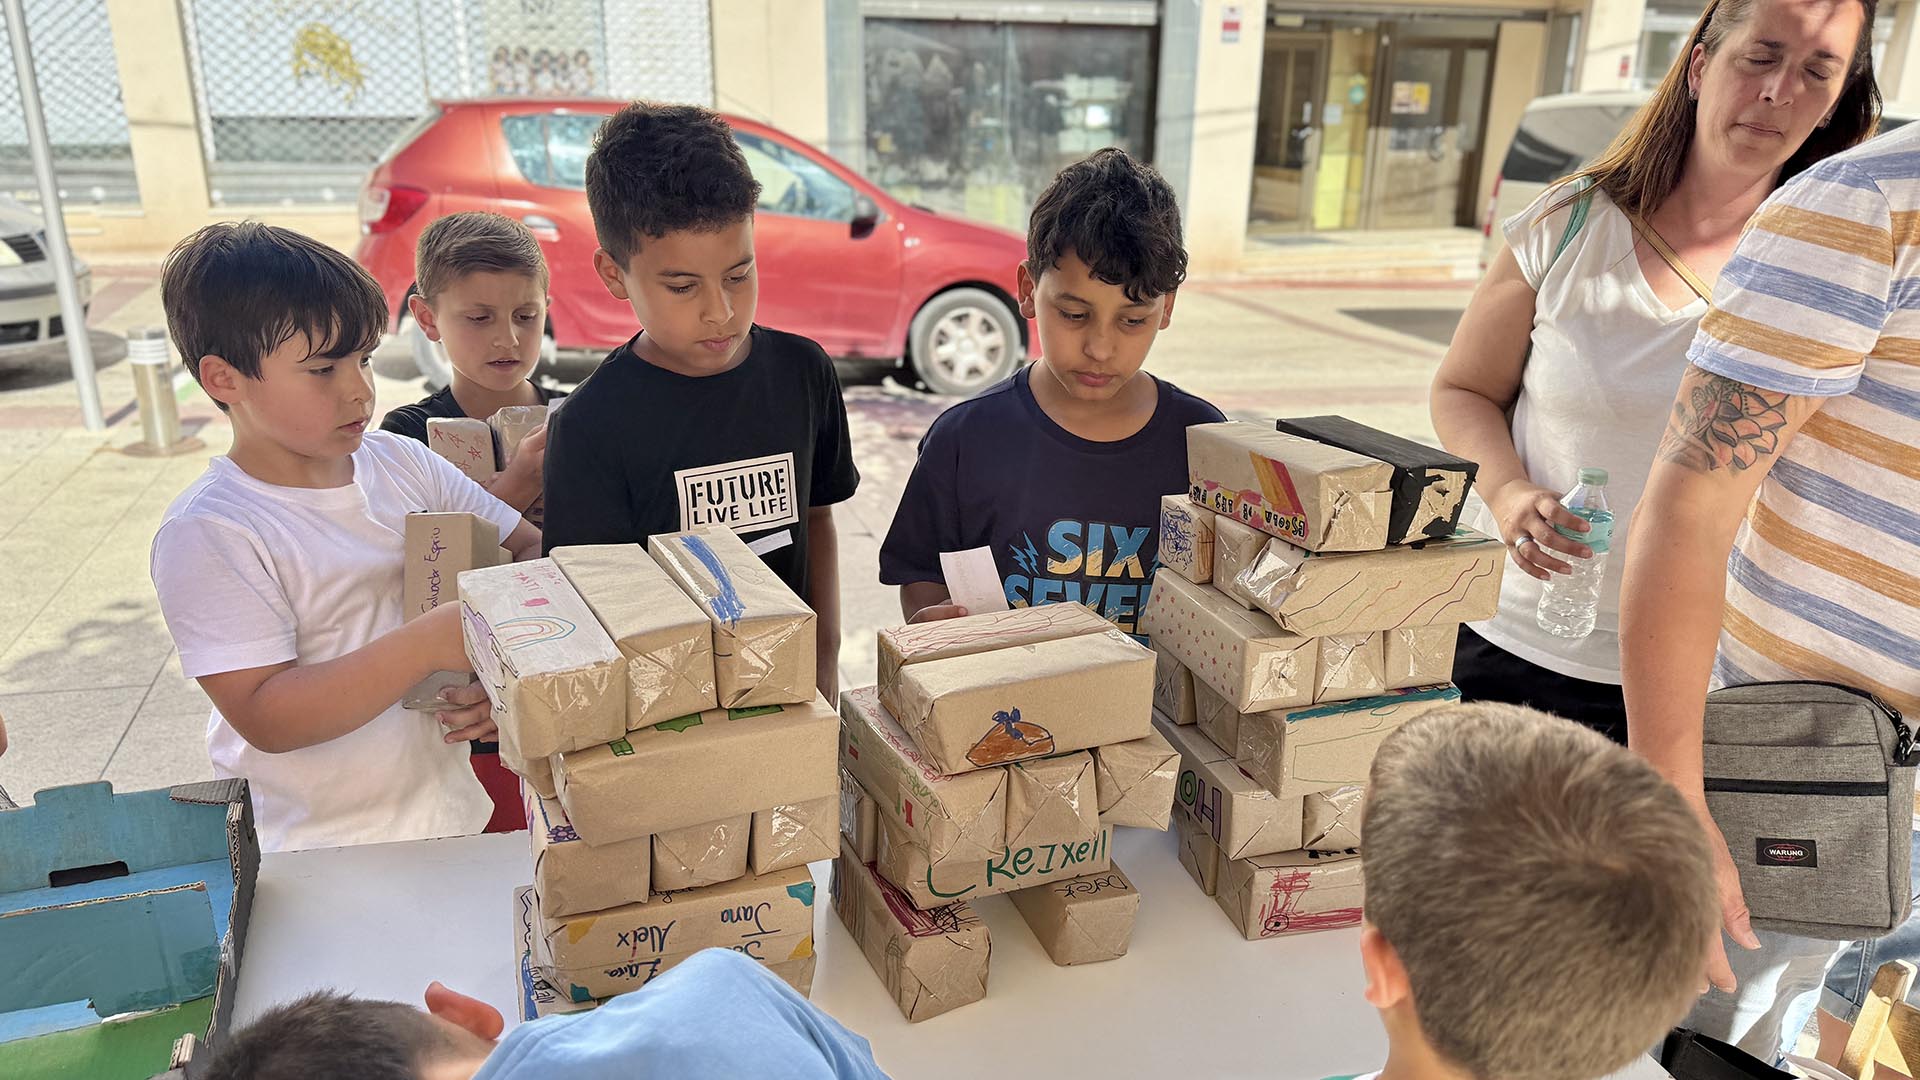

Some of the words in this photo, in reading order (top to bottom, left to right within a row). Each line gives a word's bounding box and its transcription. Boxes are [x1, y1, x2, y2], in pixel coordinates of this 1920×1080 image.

[690, 468, 786, 508] FUTURE
[693, 505, 740, 525] LIVE
[748, 496, 788, 518] LIFE
[1046, 520, 1151, 579] SIX
